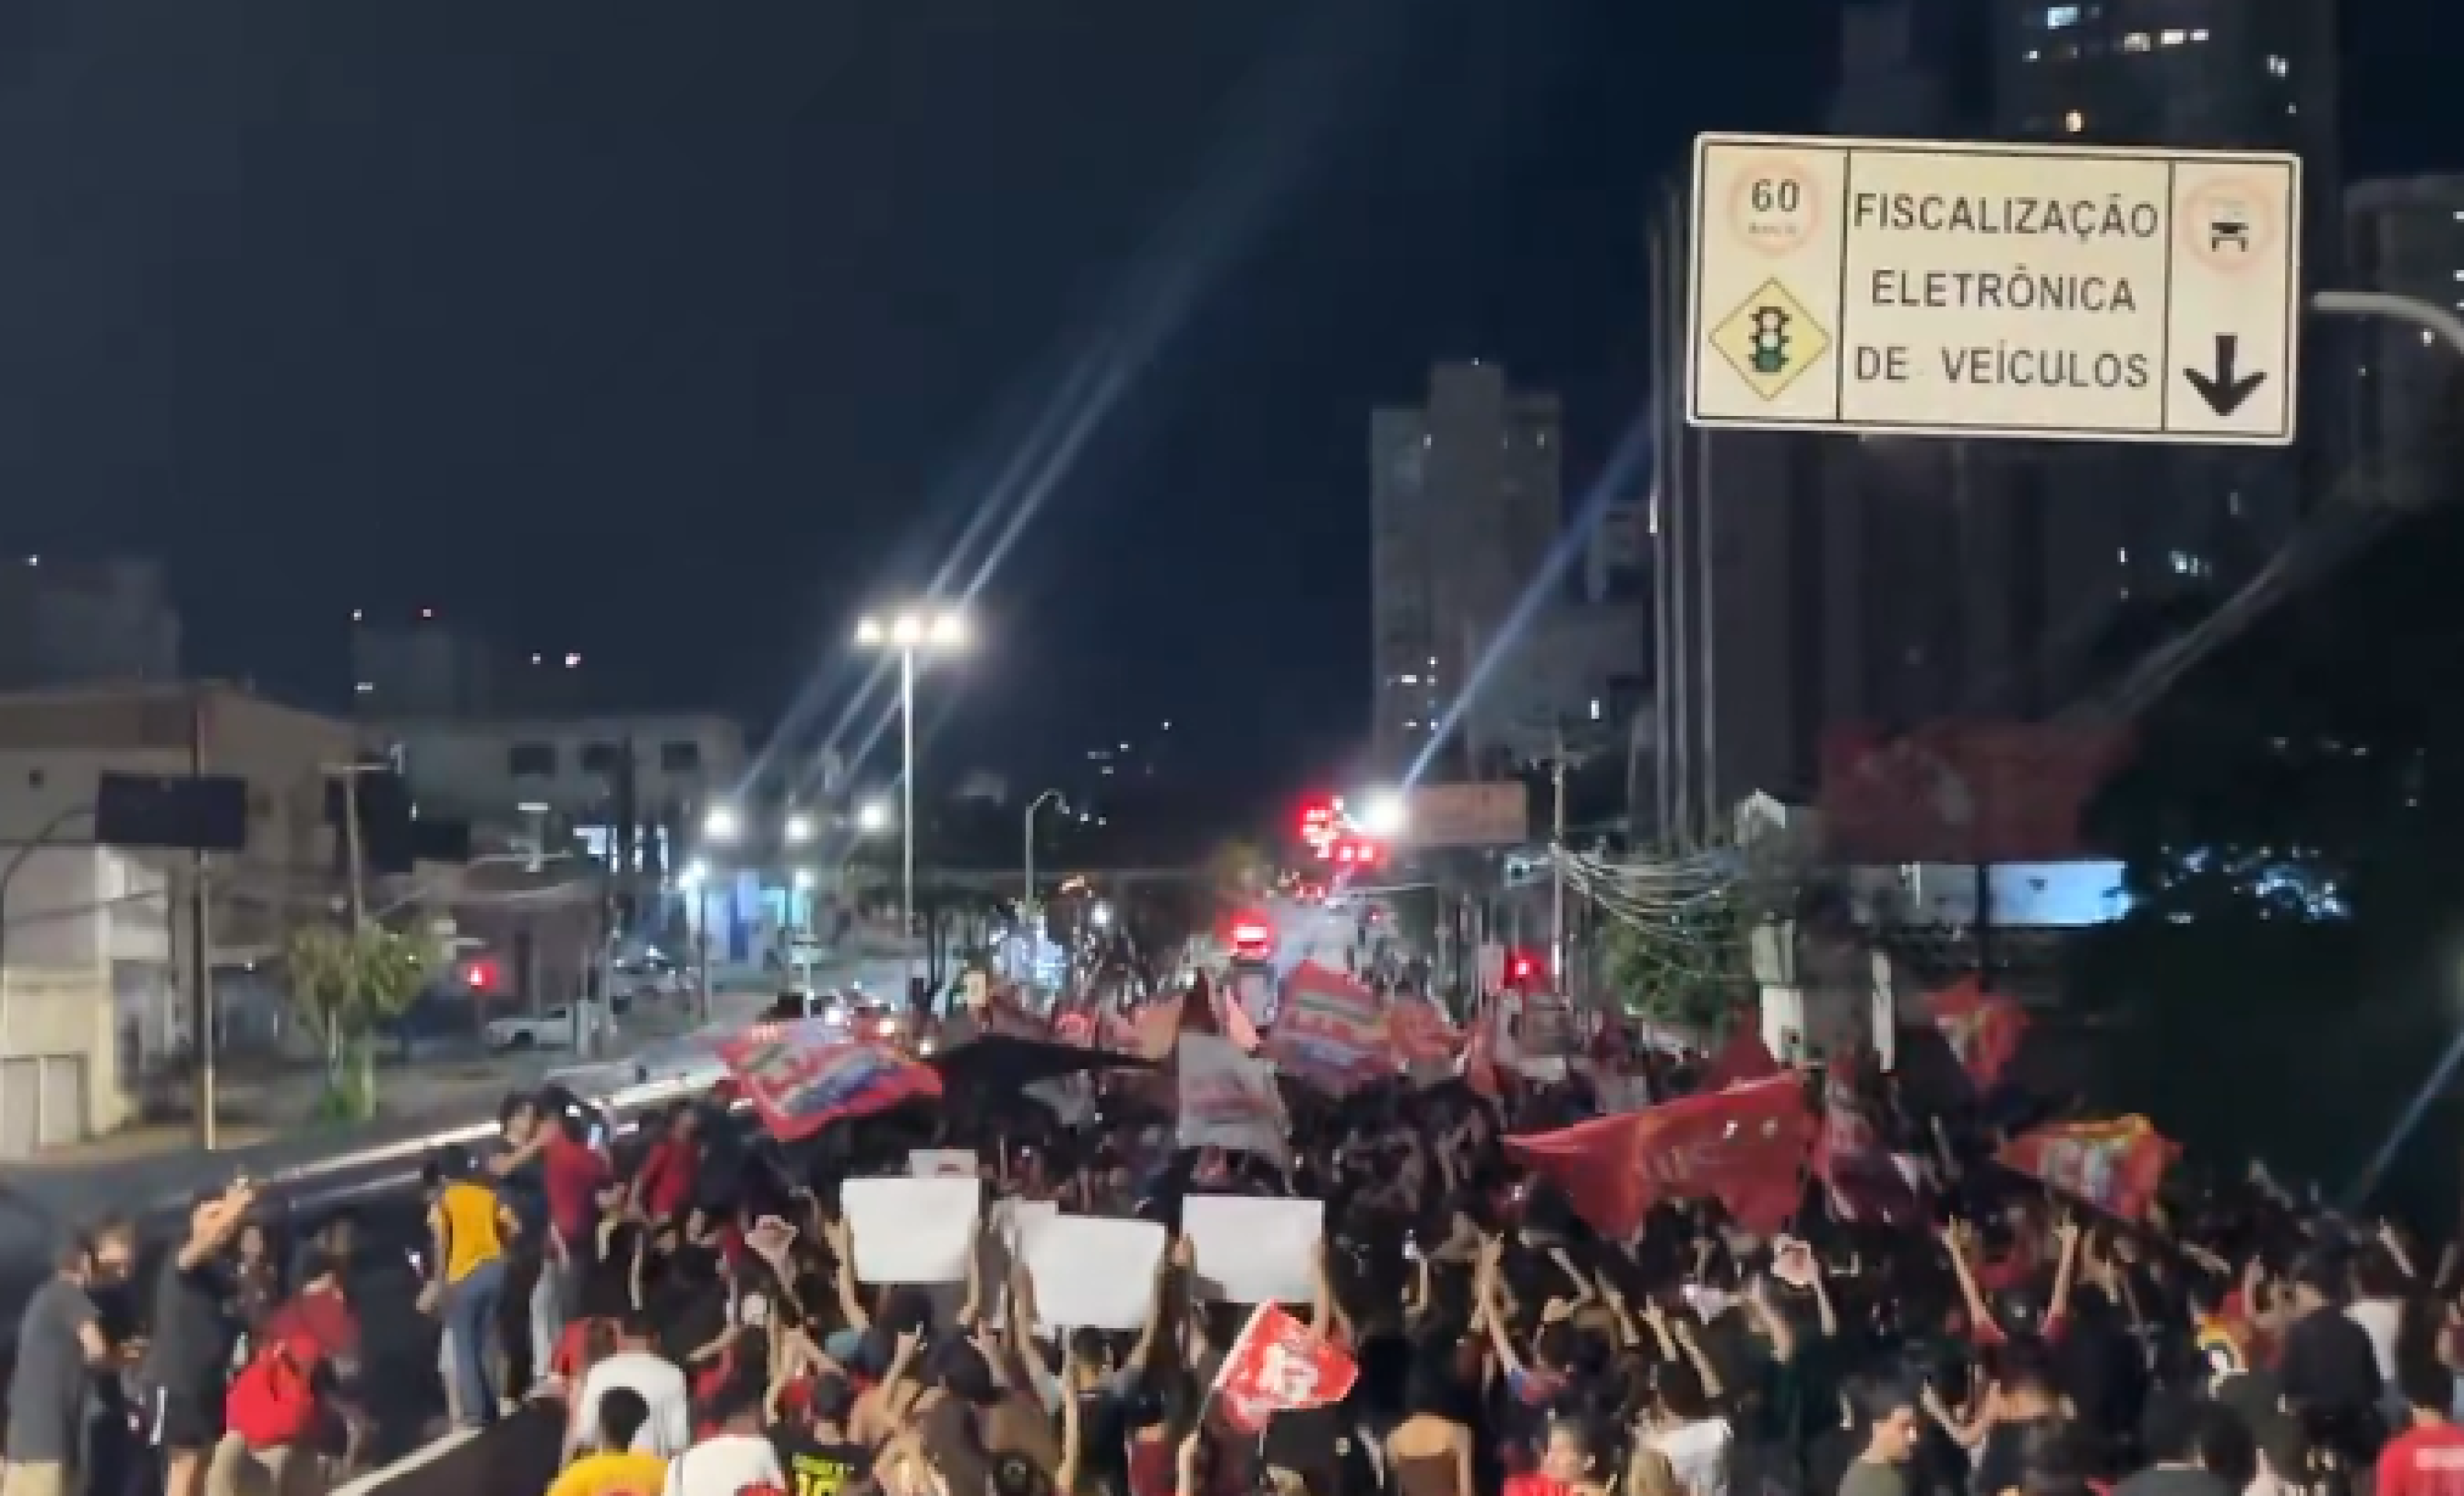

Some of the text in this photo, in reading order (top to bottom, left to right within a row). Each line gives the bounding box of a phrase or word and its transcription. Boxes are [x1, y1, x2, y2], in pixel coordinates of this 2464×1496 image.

[1752, 178, 1800, 211] 60
[1854, 193, 2158, 244] FISCALIZAÇÃO
[1871, 263, 2136, 313] ELETRÔNICA
[1854, 339, 2149, 389] DE VEÍCULOS
